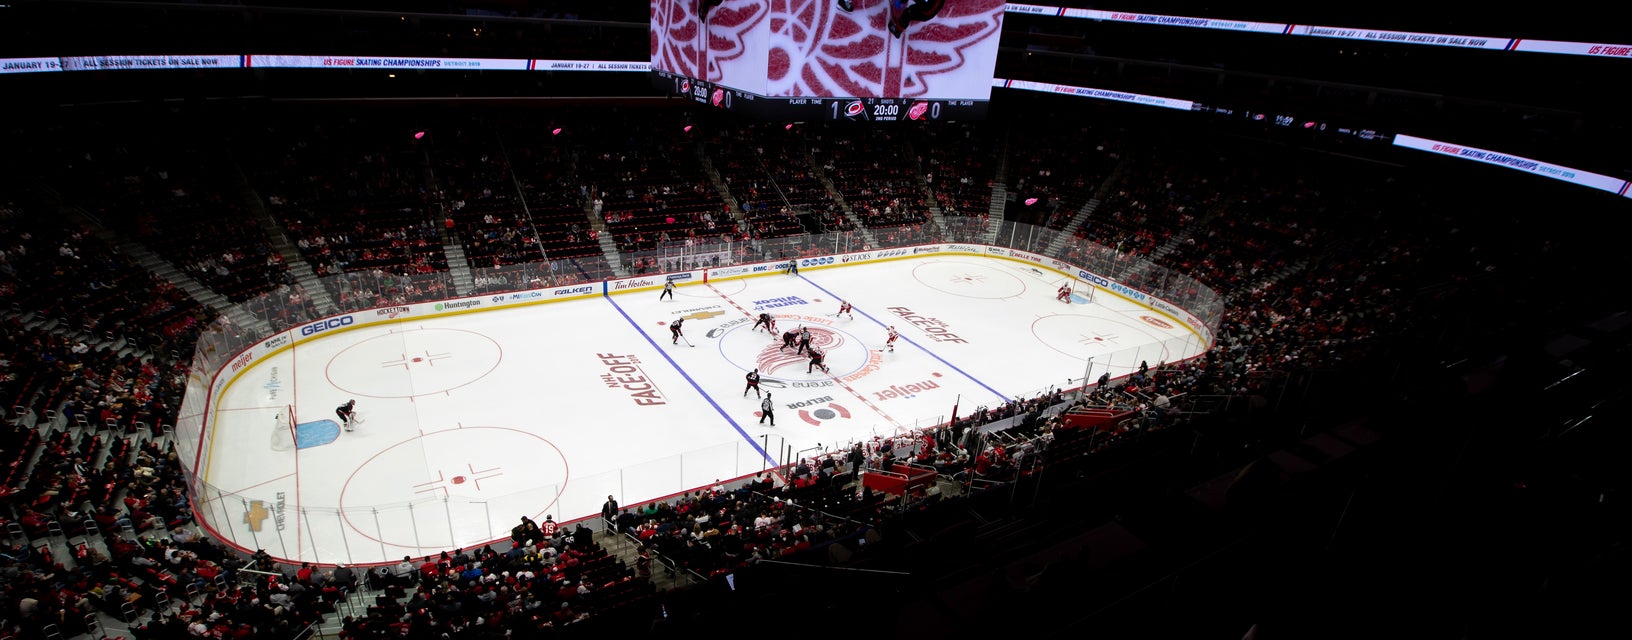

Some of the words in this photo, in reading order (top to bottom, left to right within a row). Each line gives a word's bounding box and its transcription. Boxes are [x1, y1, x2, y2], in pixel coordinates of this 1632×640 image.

[1158, 16, 1208, 26] CHAMPIONSHIPS
[1378, 32, 1406, 40] SESSION
[1588, 46, 1601, 54] US
[1602, 46, 1631, 56] FIGURE
[2, 61, 42, 70] JANUARY
[45, 60, 68, 69] 19-27
[83, 60, 98, 68] ALL
[99, 60, 132, 68] SESSION
[136, 58, 166, 66] TICKETS
[382, 59, 441, 67] CHAMPIONSHIPS
[694, 85, 708, 98] 20:00
[1094, 90, 1136, 101] CHAMPIONSHIPS
[725, 90, 732, 109] 0
[832, 101, 839, 120] 1
[874, 105, 899, 116] 20:00
[931, 102, 940, 119] 0
[1440, 146, 1461, 154] FIGURE
[1460, 148, 1486, 160] SKATING
[1486, 153, 1538, 172] CHAMPIONSHIPS
[614, 281, 627, 290] Tim
[628, 279, 654, 289] Hortons
[1079, 270, 1109, 287] GEICO
[554, 286, 592, 296] FALKEN
[444, 298, 480, 310] Huntington
[752, 296, 803, 305] Wilcox
[766, 299, 808, 309] Burns
[376, 306, 410, 316] HOCKEYTOWN
[301, 315, 354, 336] GEICO
[887, 306, 969, 344] FACE-OFF
[232, 351, 253, 372] meijer
[596, 353, 666, 406] FACE-OFF
[600, 372, 621, 388] NHL
[872, 379, 940, 402] meijer
[786, 395, 834, 410] BELFOR
[276, 491, 286, 531] CHEVROLET
[545, 524, 554, 534] 19
